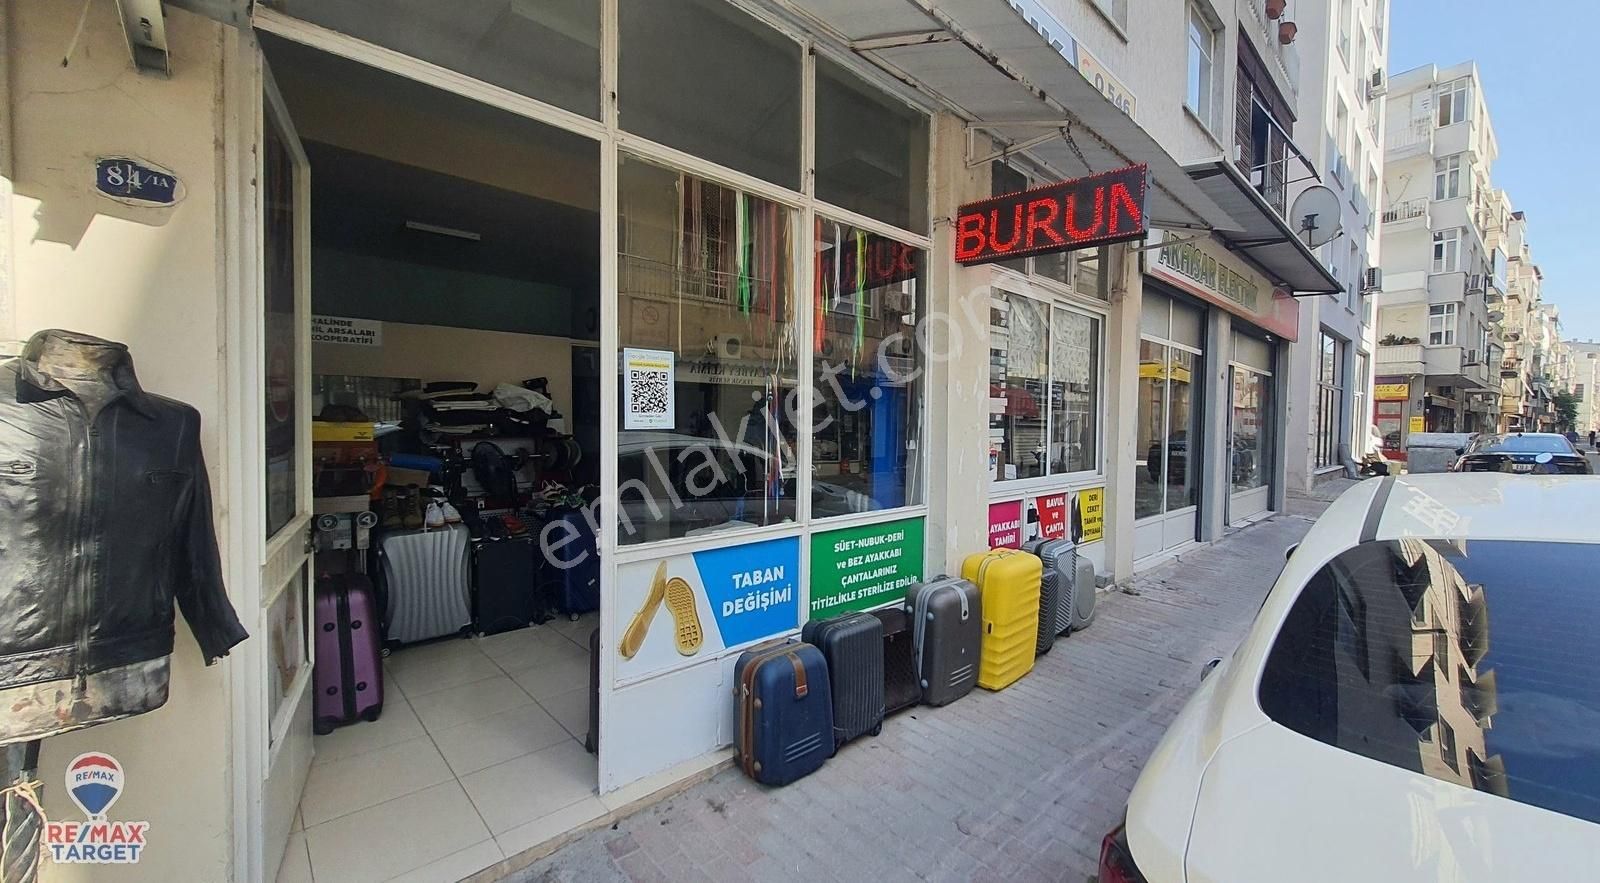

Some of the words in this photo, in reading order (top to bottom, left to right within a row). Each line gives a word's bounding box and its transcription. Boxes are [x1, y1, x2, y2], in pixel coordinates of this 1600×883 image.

[328, 327, 375, 337] ARSALARI
[1046, 497, 1065, 508] BAVUL
[995, 532, 1016, 547] TAMİRİ
[1045, 521, 1065, 537] ÇANTA
[834, 529, 904, 553] SÜET-NUBUK-DERİ
[836, 560, 847, 570] ve
[847, 555, 863, 568] BEZ
[864, 547, 902, 563] AYAKKABI
[732, 565, 784, 589] TABAN
[841, 564, 897, 588] ÇANTALARINIZ
[722, 583, 792, 617] DEĞİŞİMİ
[811, 592, 856, 611] TİTİZLİKLE
[857, 580, 895, 599] STERİLİZE
